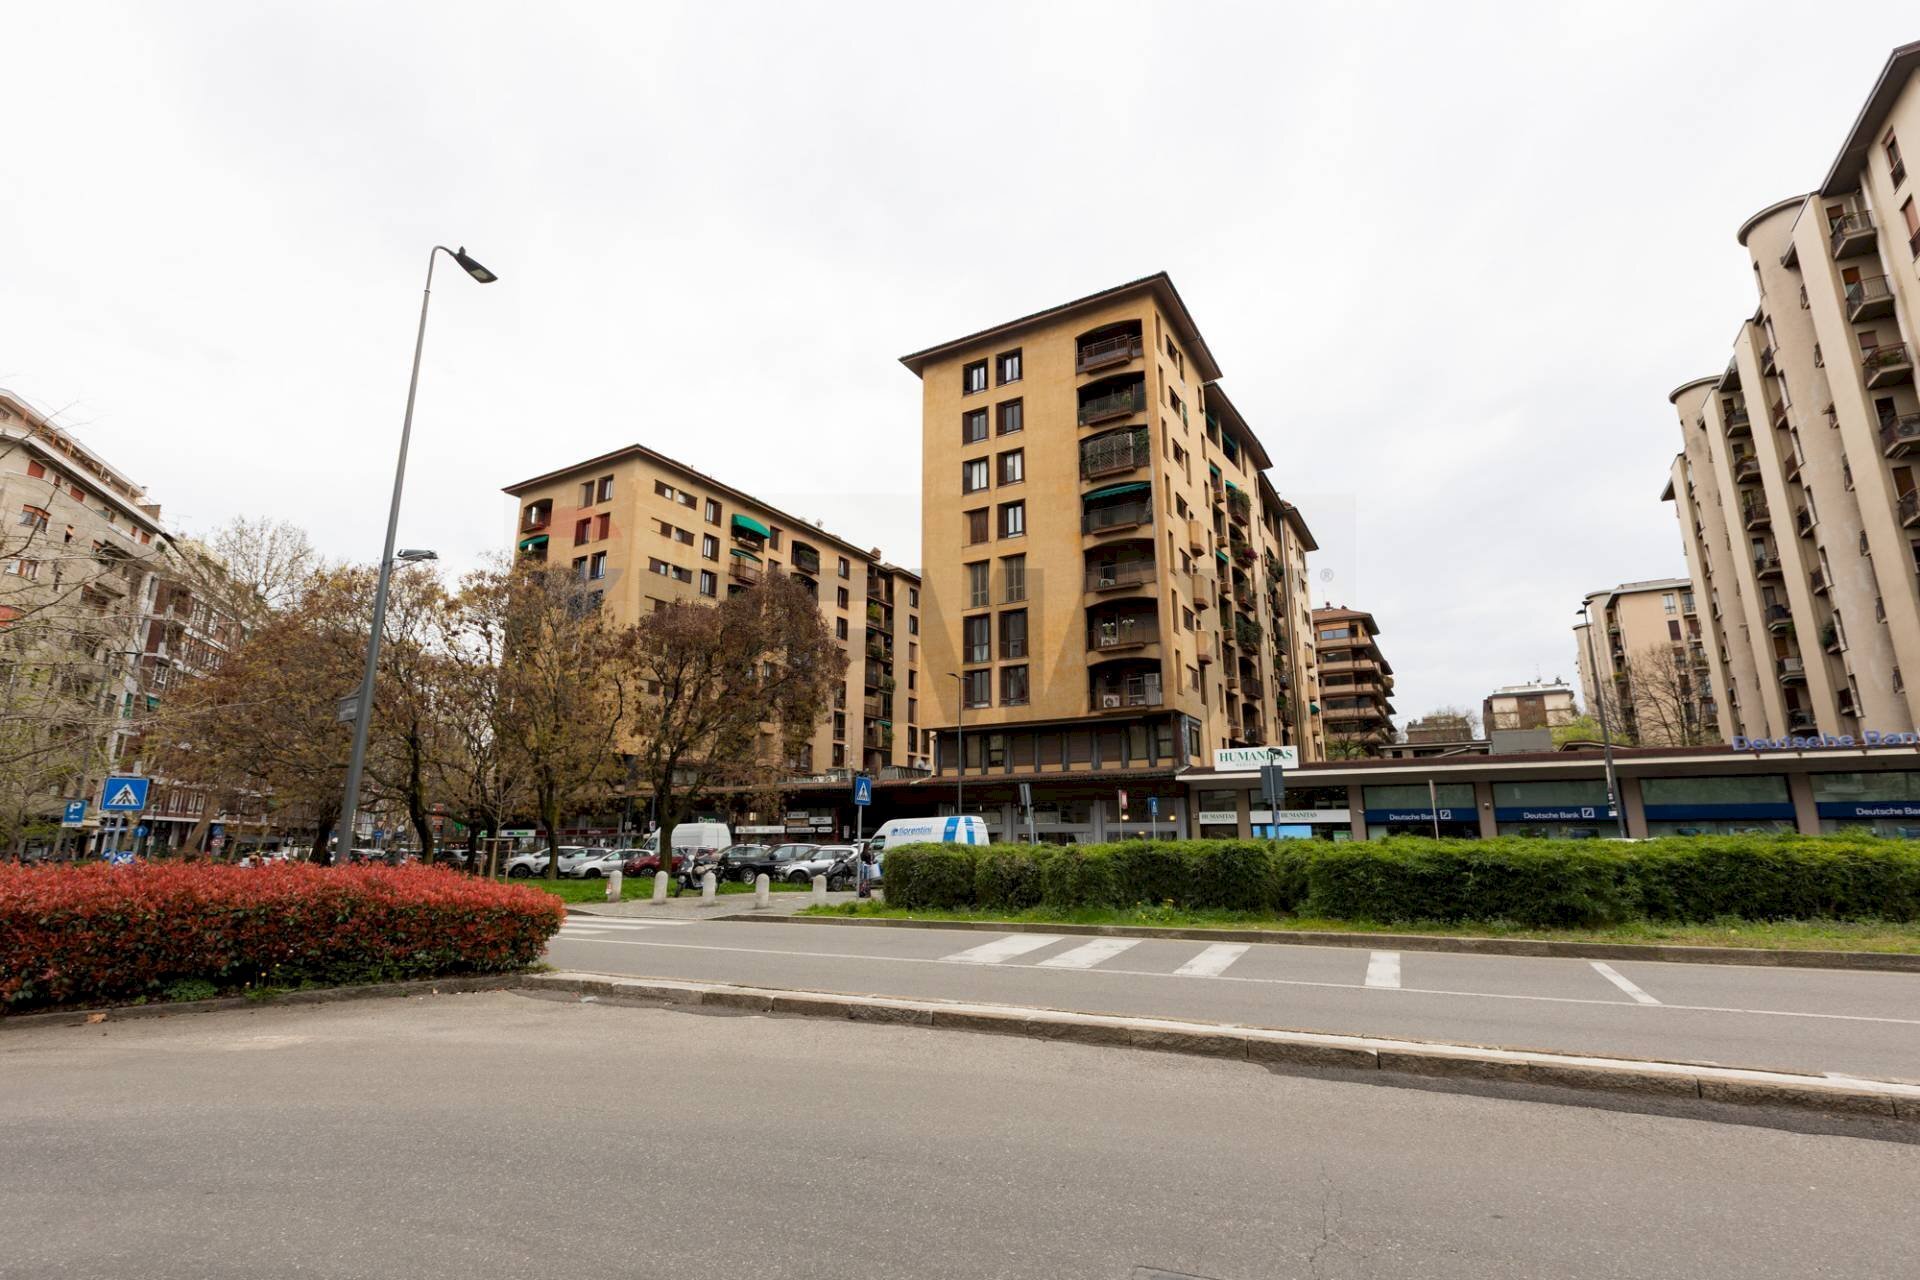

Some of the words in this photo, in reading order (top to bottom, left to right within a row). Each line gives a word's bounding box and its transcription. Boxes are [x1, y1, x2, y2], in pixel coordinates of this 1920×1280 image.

[1731, 732, 1855, 751] Deutsche
[1862, 728, 1920, 746] Ban
[1523, 811, 1559, 819] Deutsche
[1560, 811, 1580, 819] Bank
[1855, 807, 1903, 816] Deutsche
[1389, 813, 1420, 821] Deutsche
